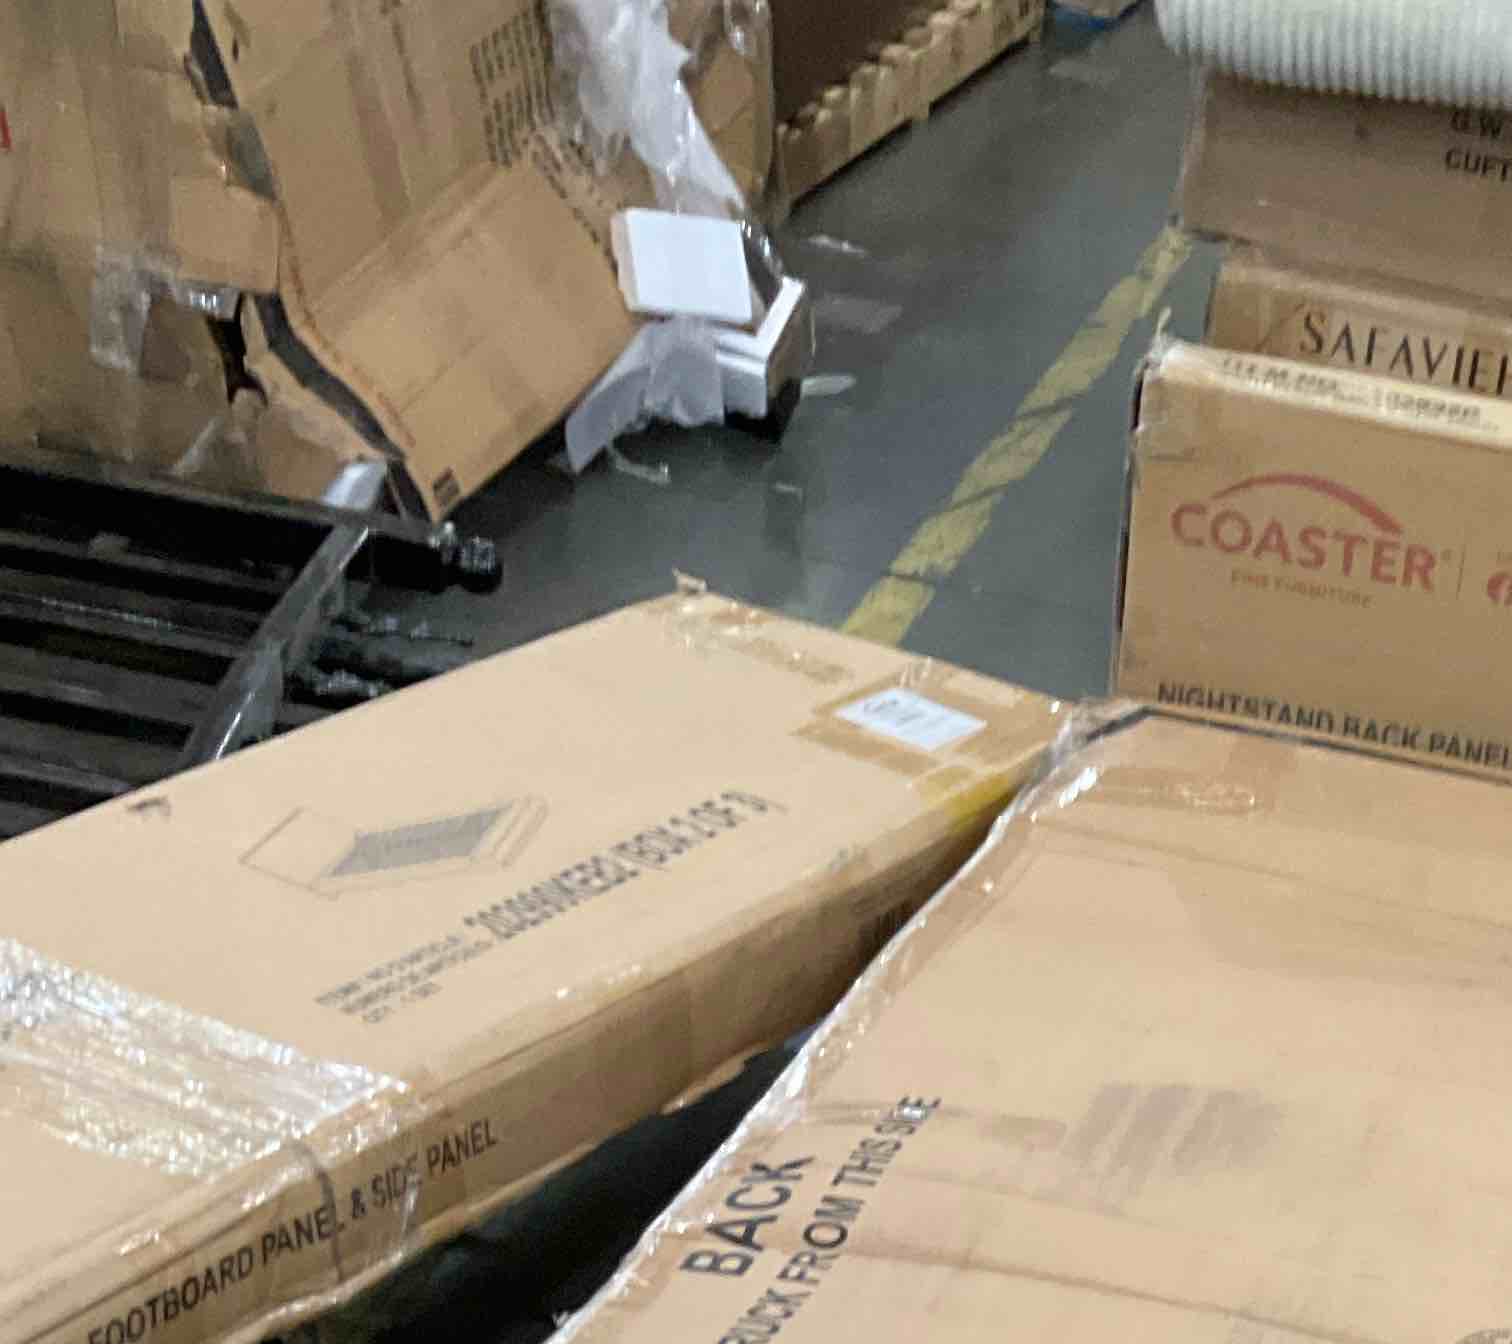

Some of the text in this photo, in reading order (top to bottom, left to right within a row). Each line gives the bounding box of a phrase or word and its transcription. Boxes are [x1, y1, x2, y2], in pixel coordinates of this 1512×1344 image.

[1169, 500, 1438, 593] COASTER
[1156, 681, 1334, 736] NIGHTSTAND
[1343, 716, 1420, 753] BACK
[1429, 732, 1512, 770] PANEL
[262, 1207, 346, 1267] PANEL
[351, 1188, 367, 1220] &
[371, 1153, 422, 1210] SIDE
[427, 1119, 498, 1177] PANEL
[679, 1155, 815, 1277] BACK
[776, 1195, 865, 1286] FROM
[830, 1138, 903, 1188] THIS
